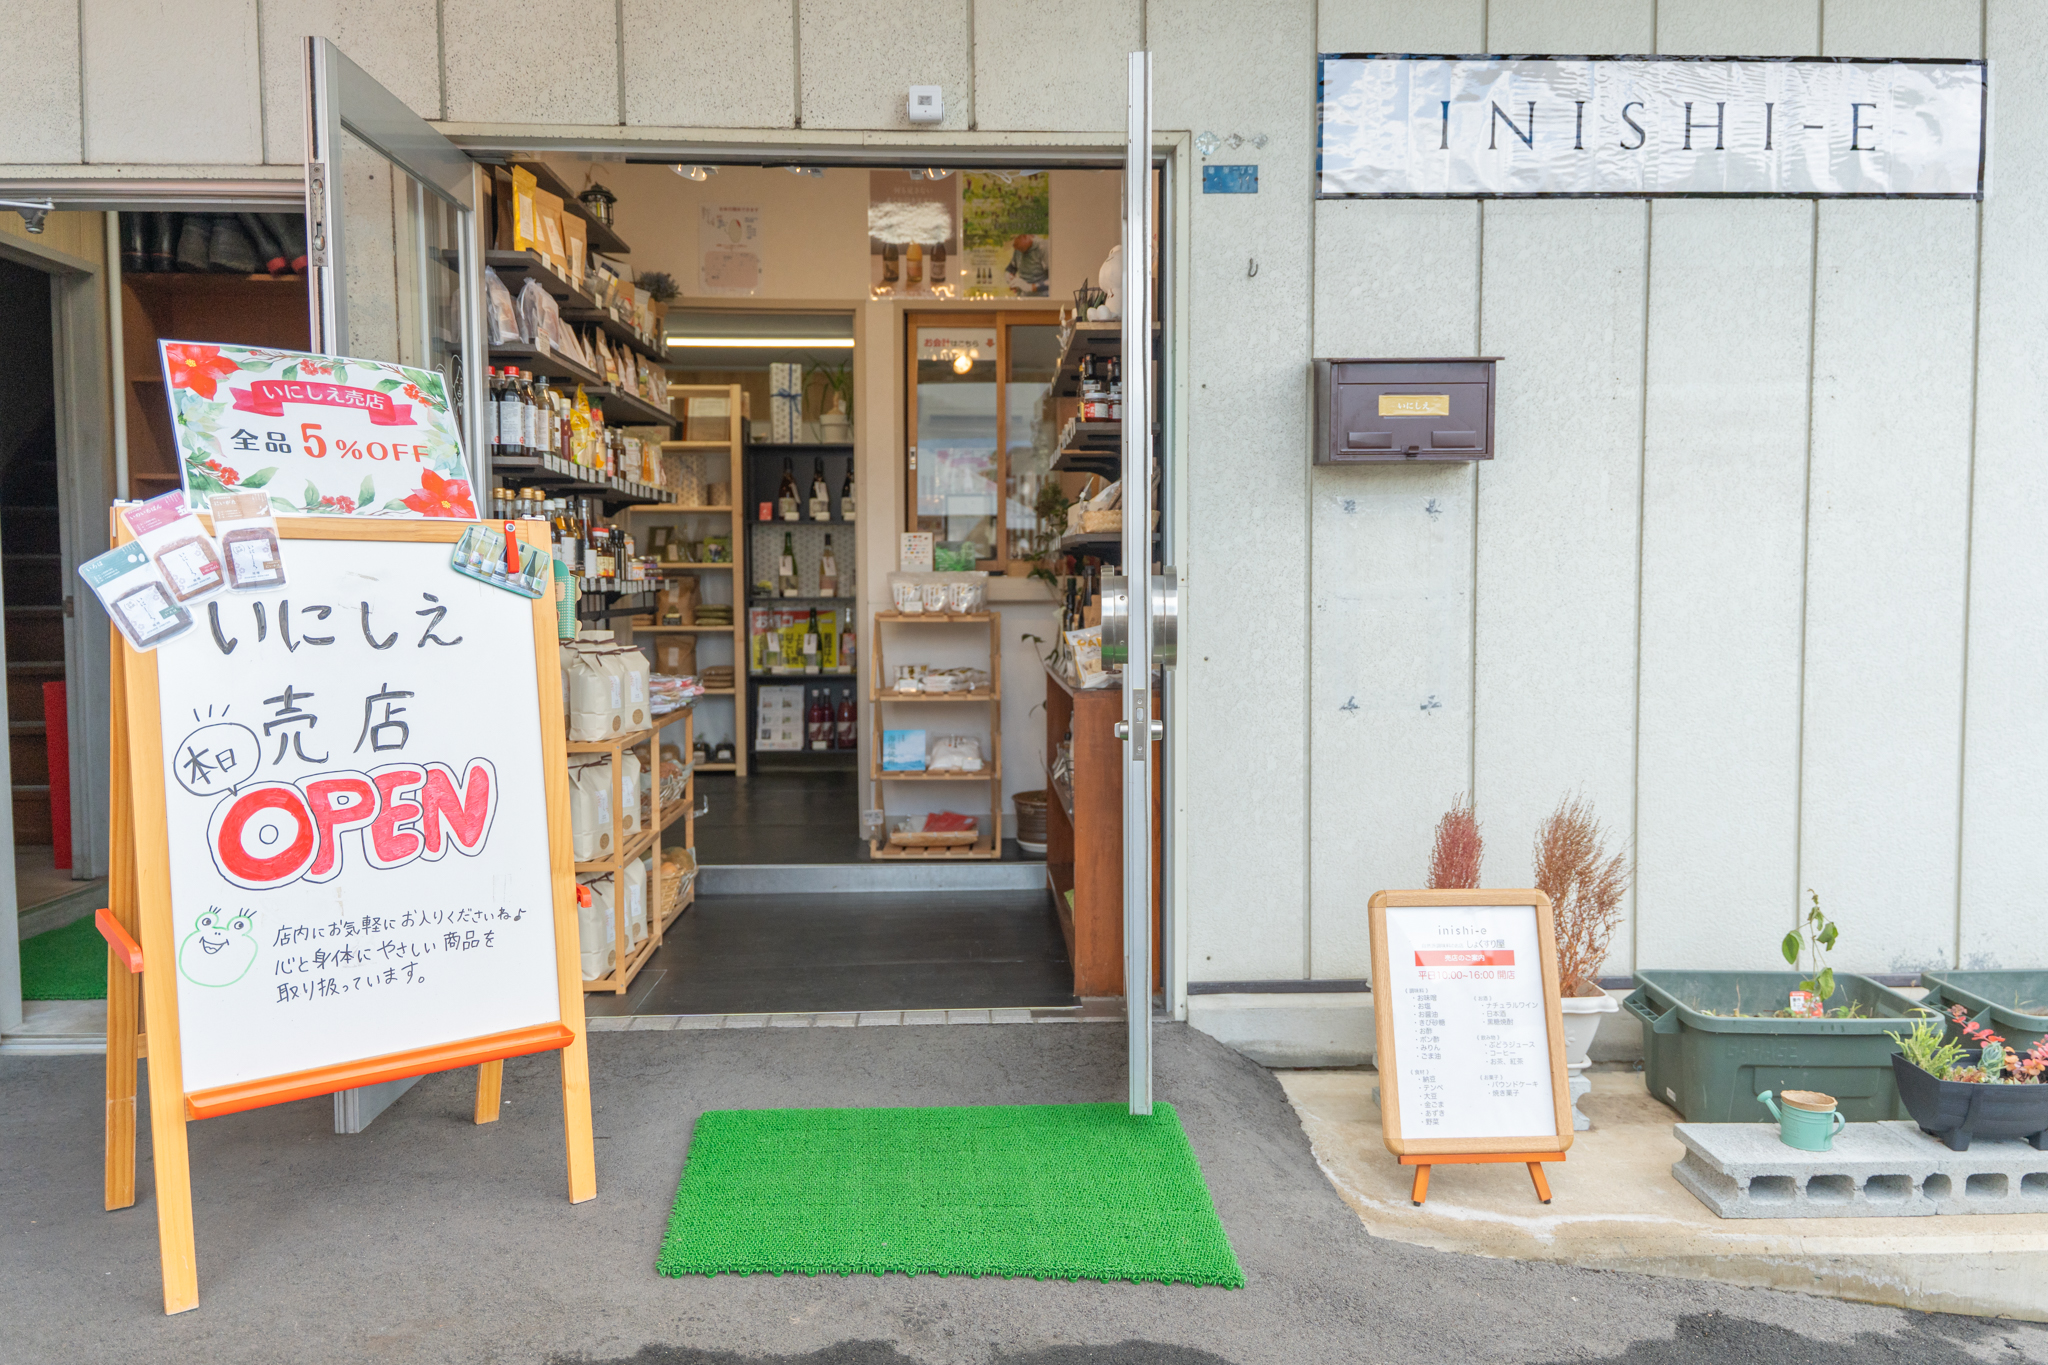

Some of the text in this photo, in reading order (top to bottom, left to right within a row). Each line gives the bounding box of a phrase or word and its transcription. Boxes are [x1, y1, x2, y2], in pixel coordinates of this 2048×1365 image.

[1438, 100, 1878, 152] INISHI-E
[924, 338, 979, 348] お会計はこちら
[262, 382, 386, 412] いにしえ売店
[1397, 401, 1430, 411] いにしえ
[230, 428, 293, 454] 全品
[84, 561, 104, 573] いろは
[207, 591, 464, 655] いにしえ
[263, 682, 416, 766] 売店
[183, 744, 238, 785] 本日
[214, 762, 494, 886] OPEN
[1438, 925, 1488, 936] inishi-e
[1444, 953, 1485, 962] 売店のご案内
[1497, 970, 1516, 980] 開店
